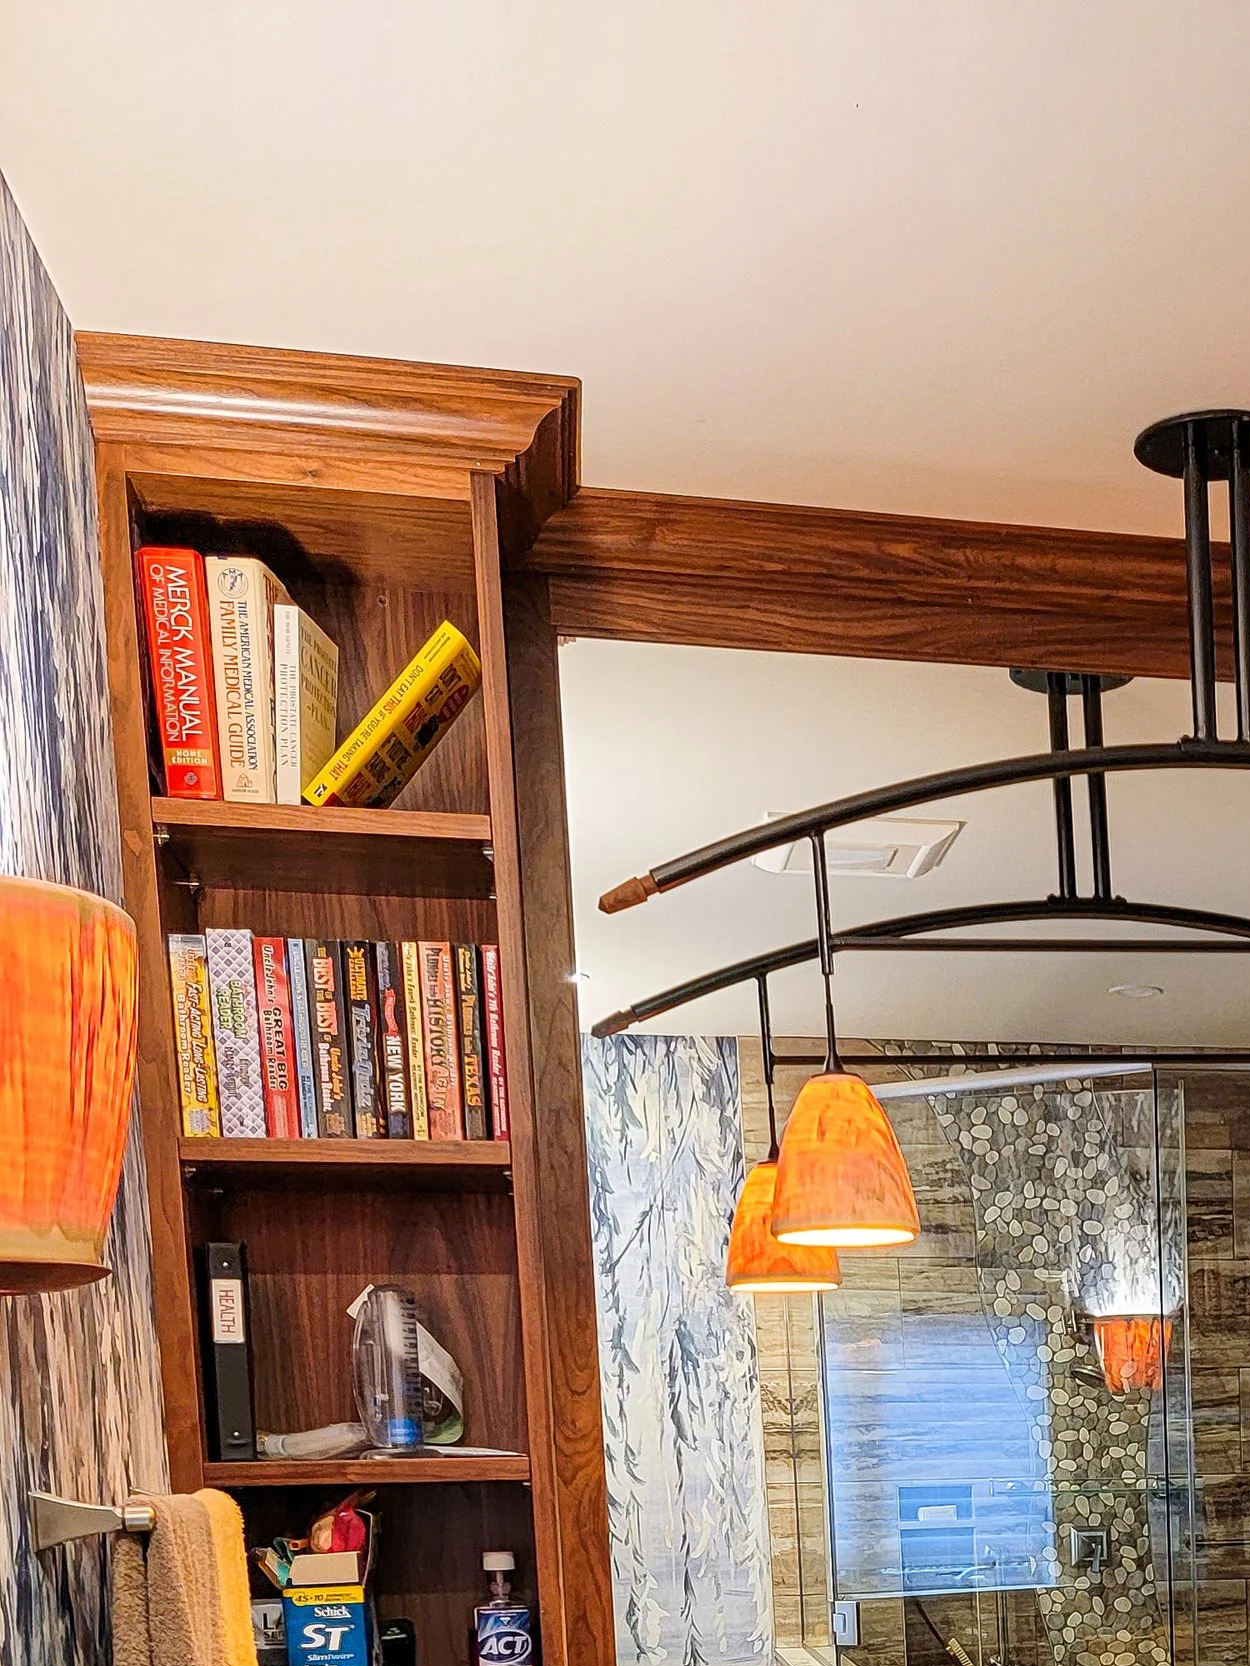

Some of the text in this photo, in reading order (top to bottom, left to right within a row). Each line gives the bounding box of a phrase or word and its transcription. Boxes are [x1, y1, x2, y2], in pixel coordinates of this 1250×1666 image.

[149, 563, 181, 742] OF MEDICAL INFORMATION
[165, 565, 203, 742] MERCK MANUAL
[220, 600, 245, 769] FAMILY MEDICAL GUIDE
[238, 600, 258, 771] THE AMERICAN MEDICAL ASSOCIATION
[280, 663, 289, 766] PROTECTION PLAN
[329, 664, 424, 781] DON'T EAT THIS IF YOU'RE TAKING THAT
[171, 749, 208, 764] HOME EDITION
[290, 732, 298, 768] CANCER
[313, 957, 335, 992] BEST
[354, 957, 368, 1001] ULTIMATE
[216, 988, 232, 1030] READER
[229, 980, 248, 1040] BATHROOM
[325, 991, 333, 1000] OF
[273, 1007, 287, 1058] GREAT
[316, 1001, 338, 1036] BEST
[427, 998, 447, 1067] HISTORY
[489, 1013, 500, 1047] Bathroom
[177, 994, 191, 1093] Bathroom Reader
[263, 1009, 277, 1090] Bathroom Reader
[318, 1043, 331, 1081] Bathroom
[329, 1047, 342, 1072] Uncle
[386, 1036, 403, 1069] NEW
[491, 1048, 502, 1075] Reader
[277, 1062, 288, 1091] BIG
[331, 1072, 345, 1100] John's
[388, 1071, 406, 1112] YORK
[465, 1054, 483, 1106] TEXAS
[218, 1289, 236, 1334] HEALTH
[314, 1604, 351, 1618] Schick
[300, 1623, 351, 1651] ST
[480, 1635, 527, 1655] ACT
